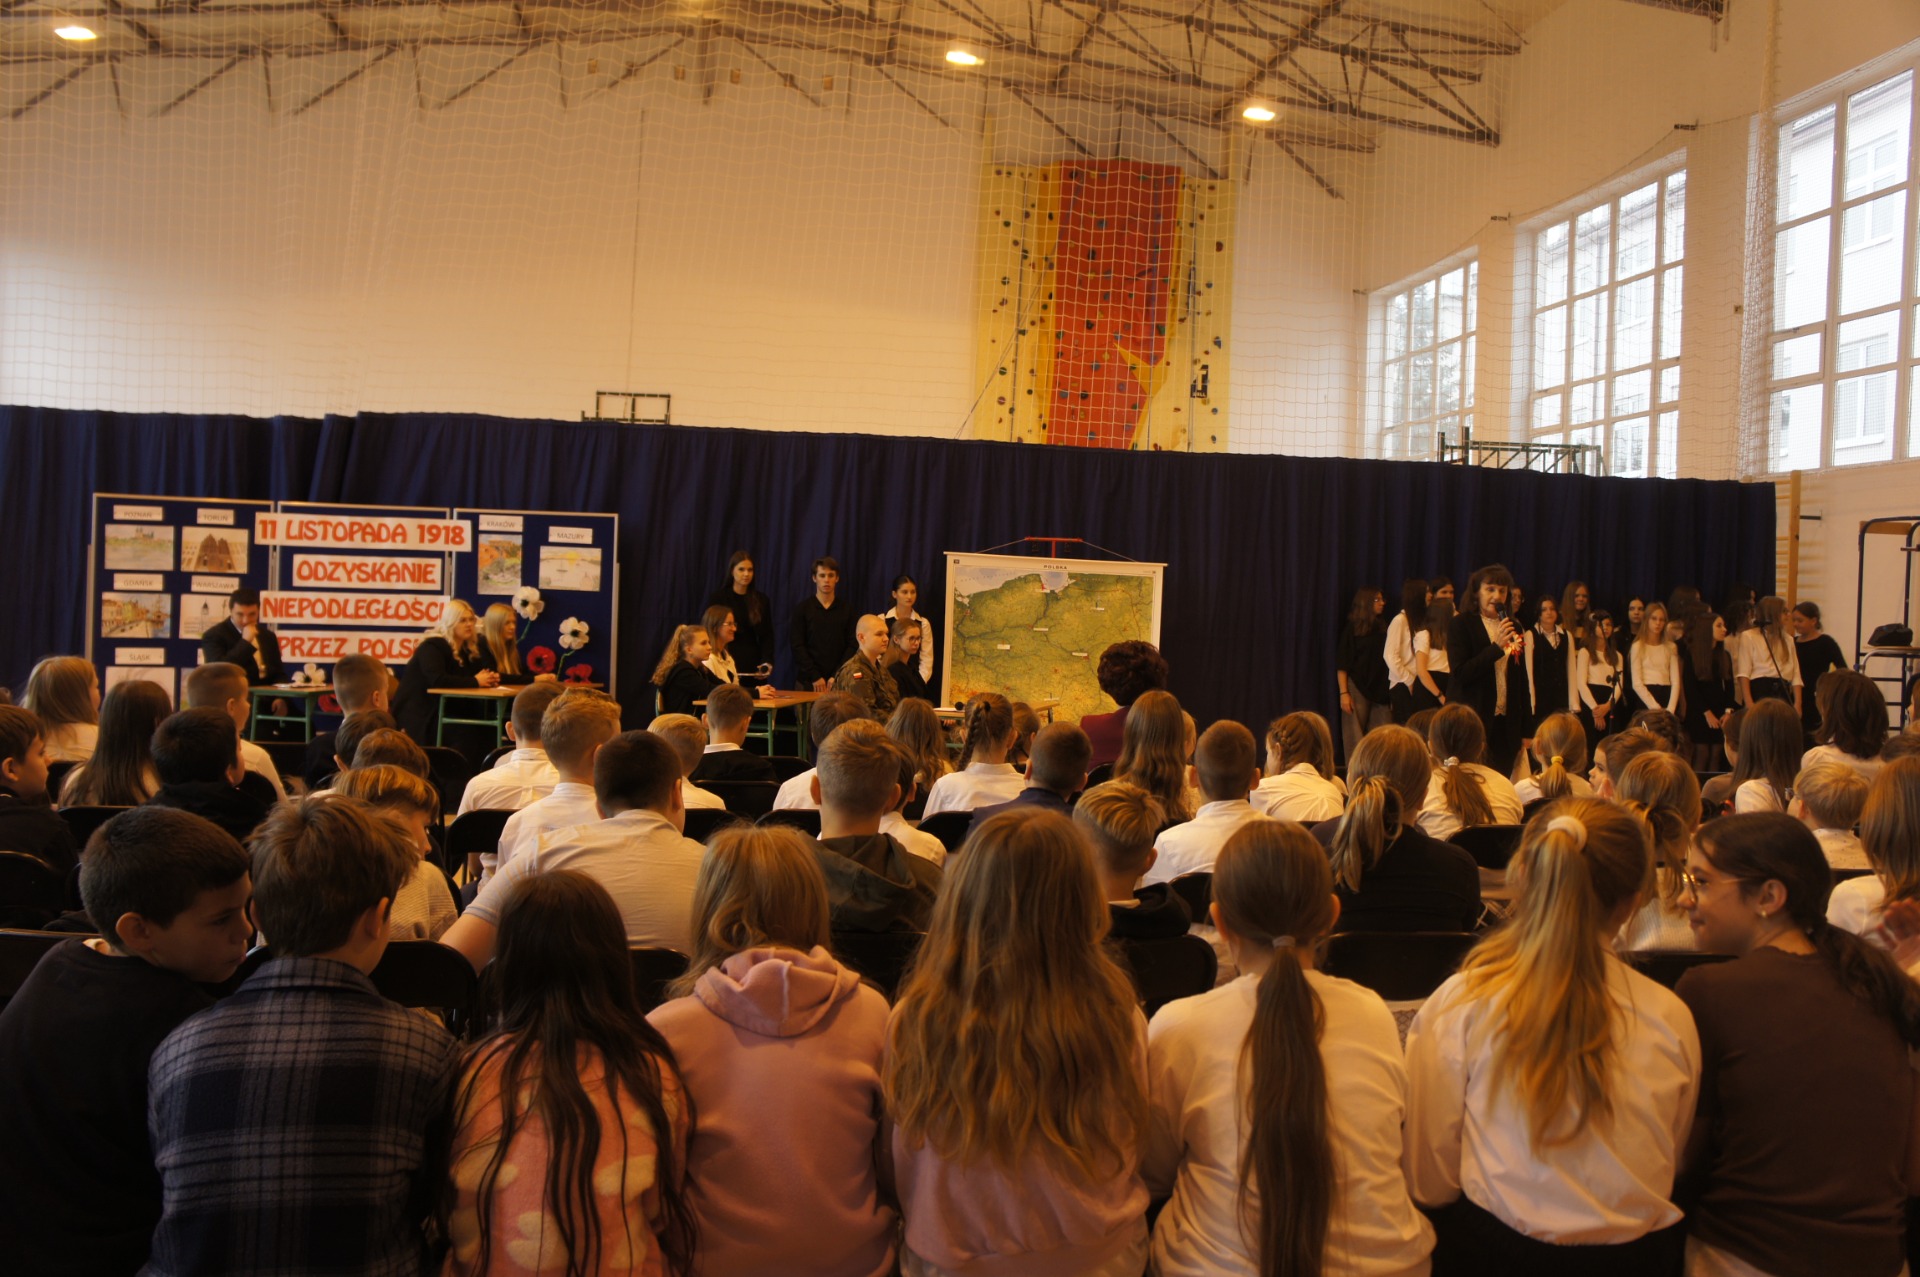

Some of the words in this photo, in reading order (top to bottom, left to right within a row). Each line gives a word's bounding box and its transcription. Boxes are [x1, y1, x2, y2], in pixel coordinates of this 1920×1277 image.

[486, 520, 516, 528] KRAKÓW
[259, 520, 277, 540] 11
[285, 520, 408, 544] LISTOPADA
[417, 524, 465, 546] 1918
[556, 532, 585, 540] MAZURY
[296, 560, 436, 584] ODZYSKANIE
[123, 579, 153, 587] GDAŃSK
[195, 581, 235, 589] WARSZAWA
[262, 597, 444, 622] NIEPODLEGŁOŚCI
[278, 636, 348, 658] PRZEZ
[129, 653, 151, 662] ŚLĄSK
